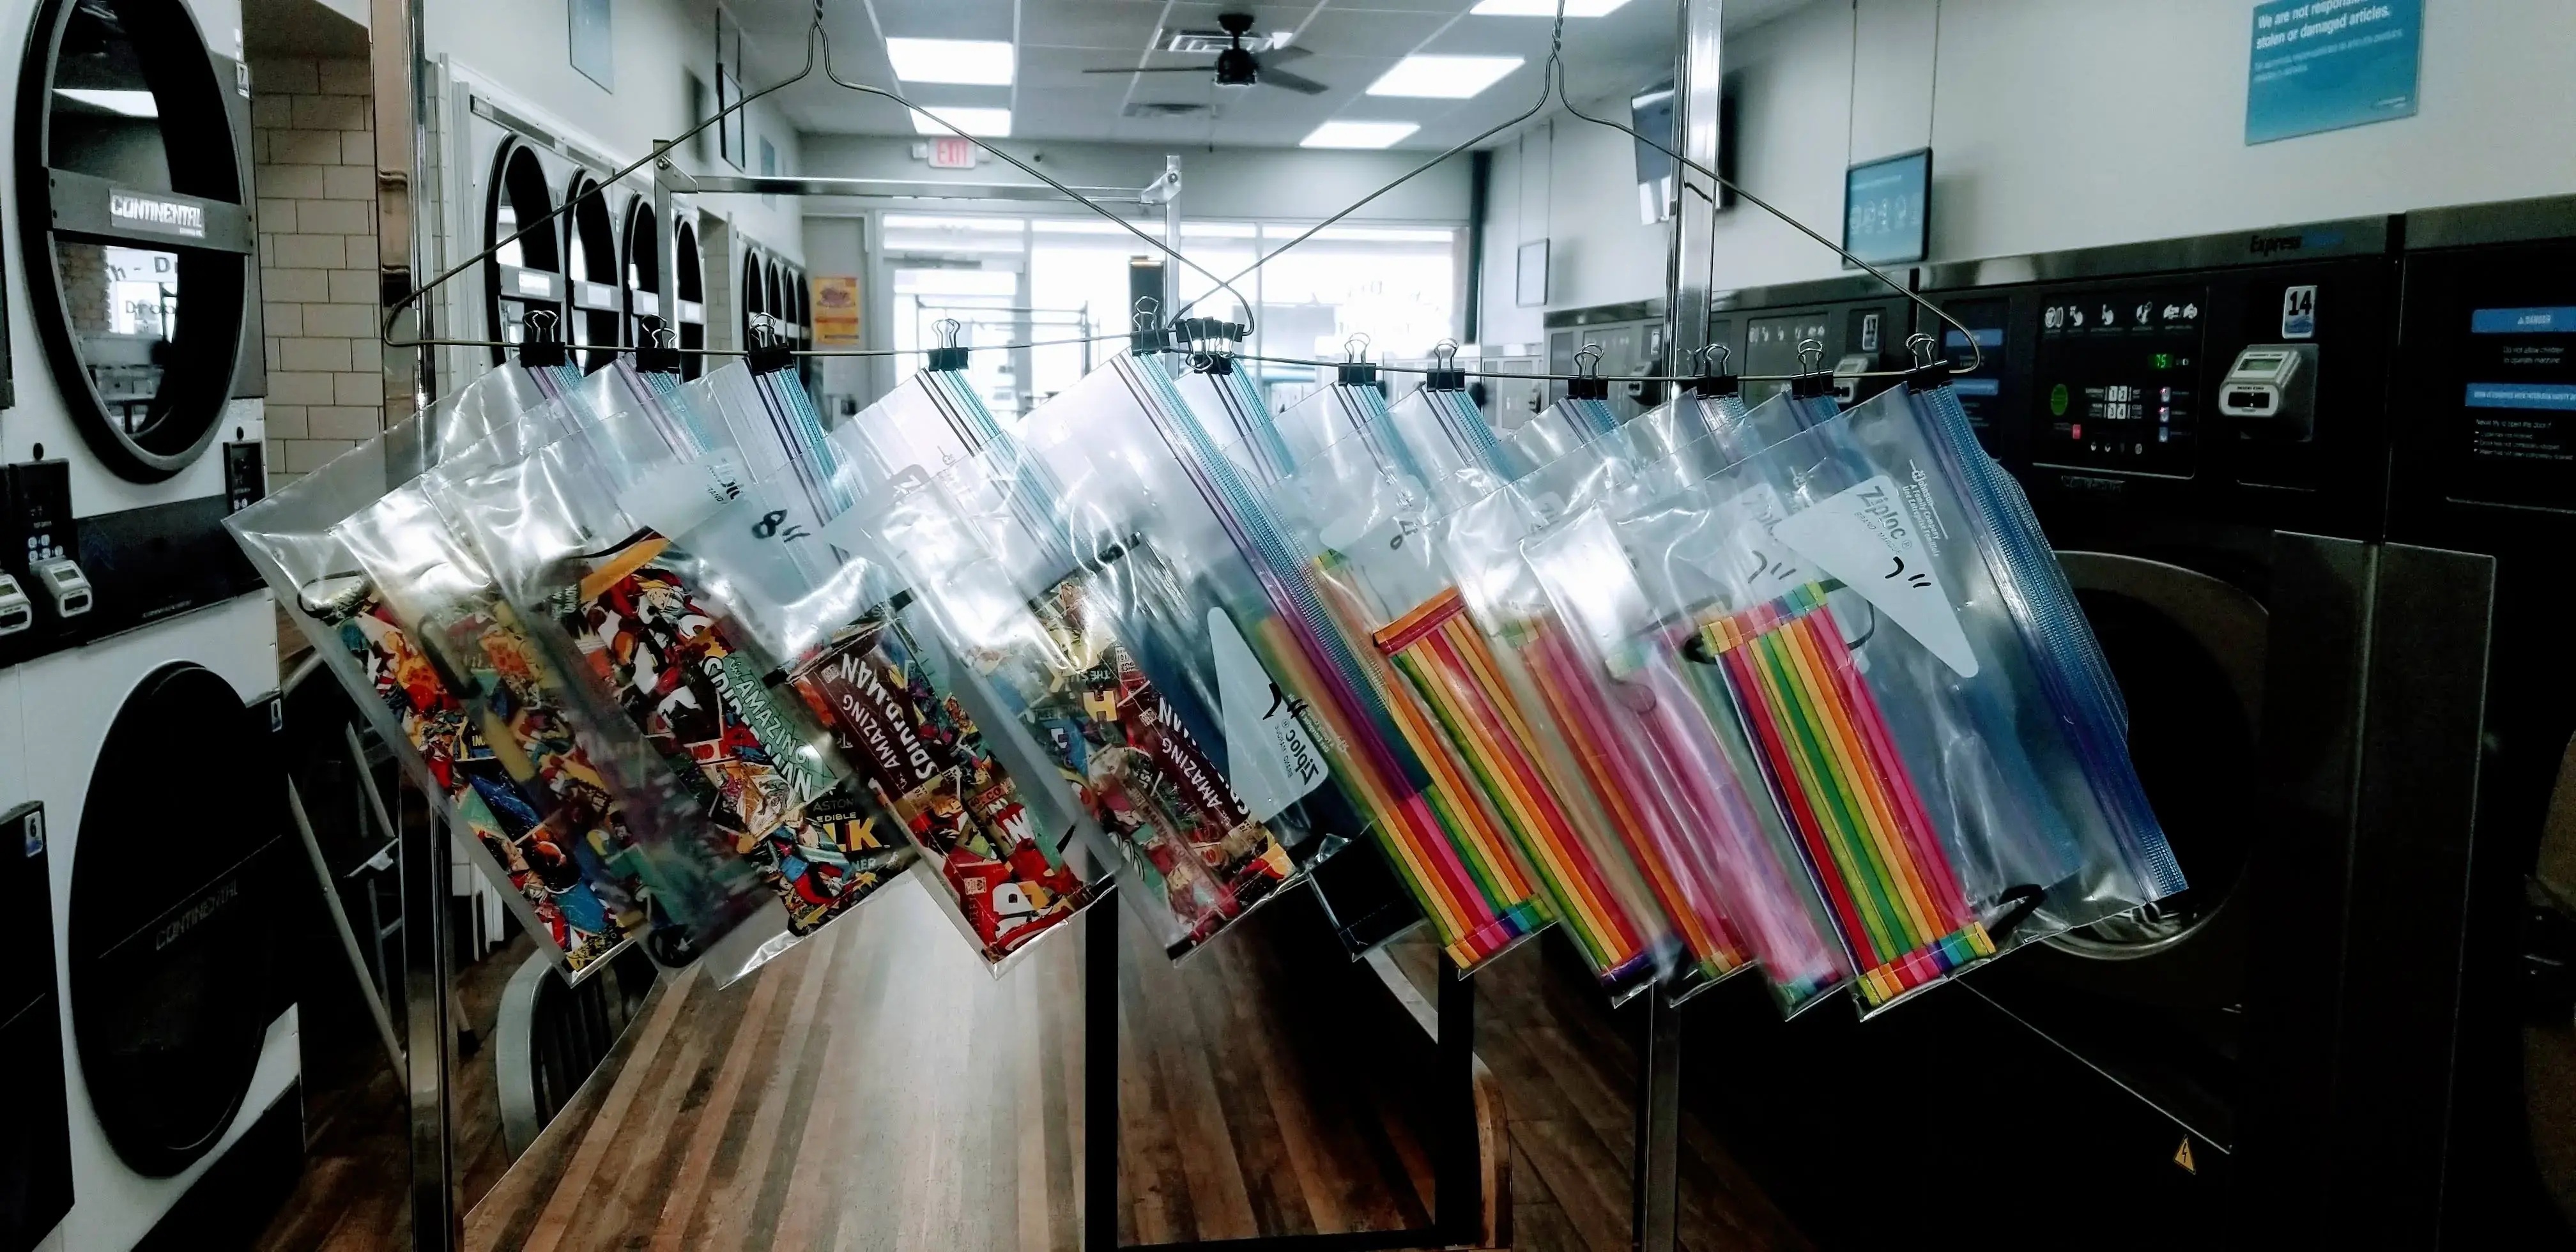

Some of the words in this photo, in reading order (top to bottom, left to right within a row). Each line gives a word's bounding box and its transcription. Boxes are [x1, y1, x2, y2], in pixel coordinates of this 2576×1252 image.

[2258, 15, 2273, 29] We
[2274, 11, 2290, 26] are
[2292, 4, 2309, 20] not
[2287, 29, 2299, 42] or
[2301, 13, 2347, 38] damaged
[938, 140, 967, 165] EXIT
[111, 194, 203, 229] CONTINENTAL
[2288, 290, 2312, 316] 14
[1856, 485, 1906, 542] Ziploc
[736, 679, 809, 764] AMAZING
[843, 694, 901, 768] AMAZING
[1162, 737, 1223, 809] AMAZING
[29, 818, 37, 837] 6
